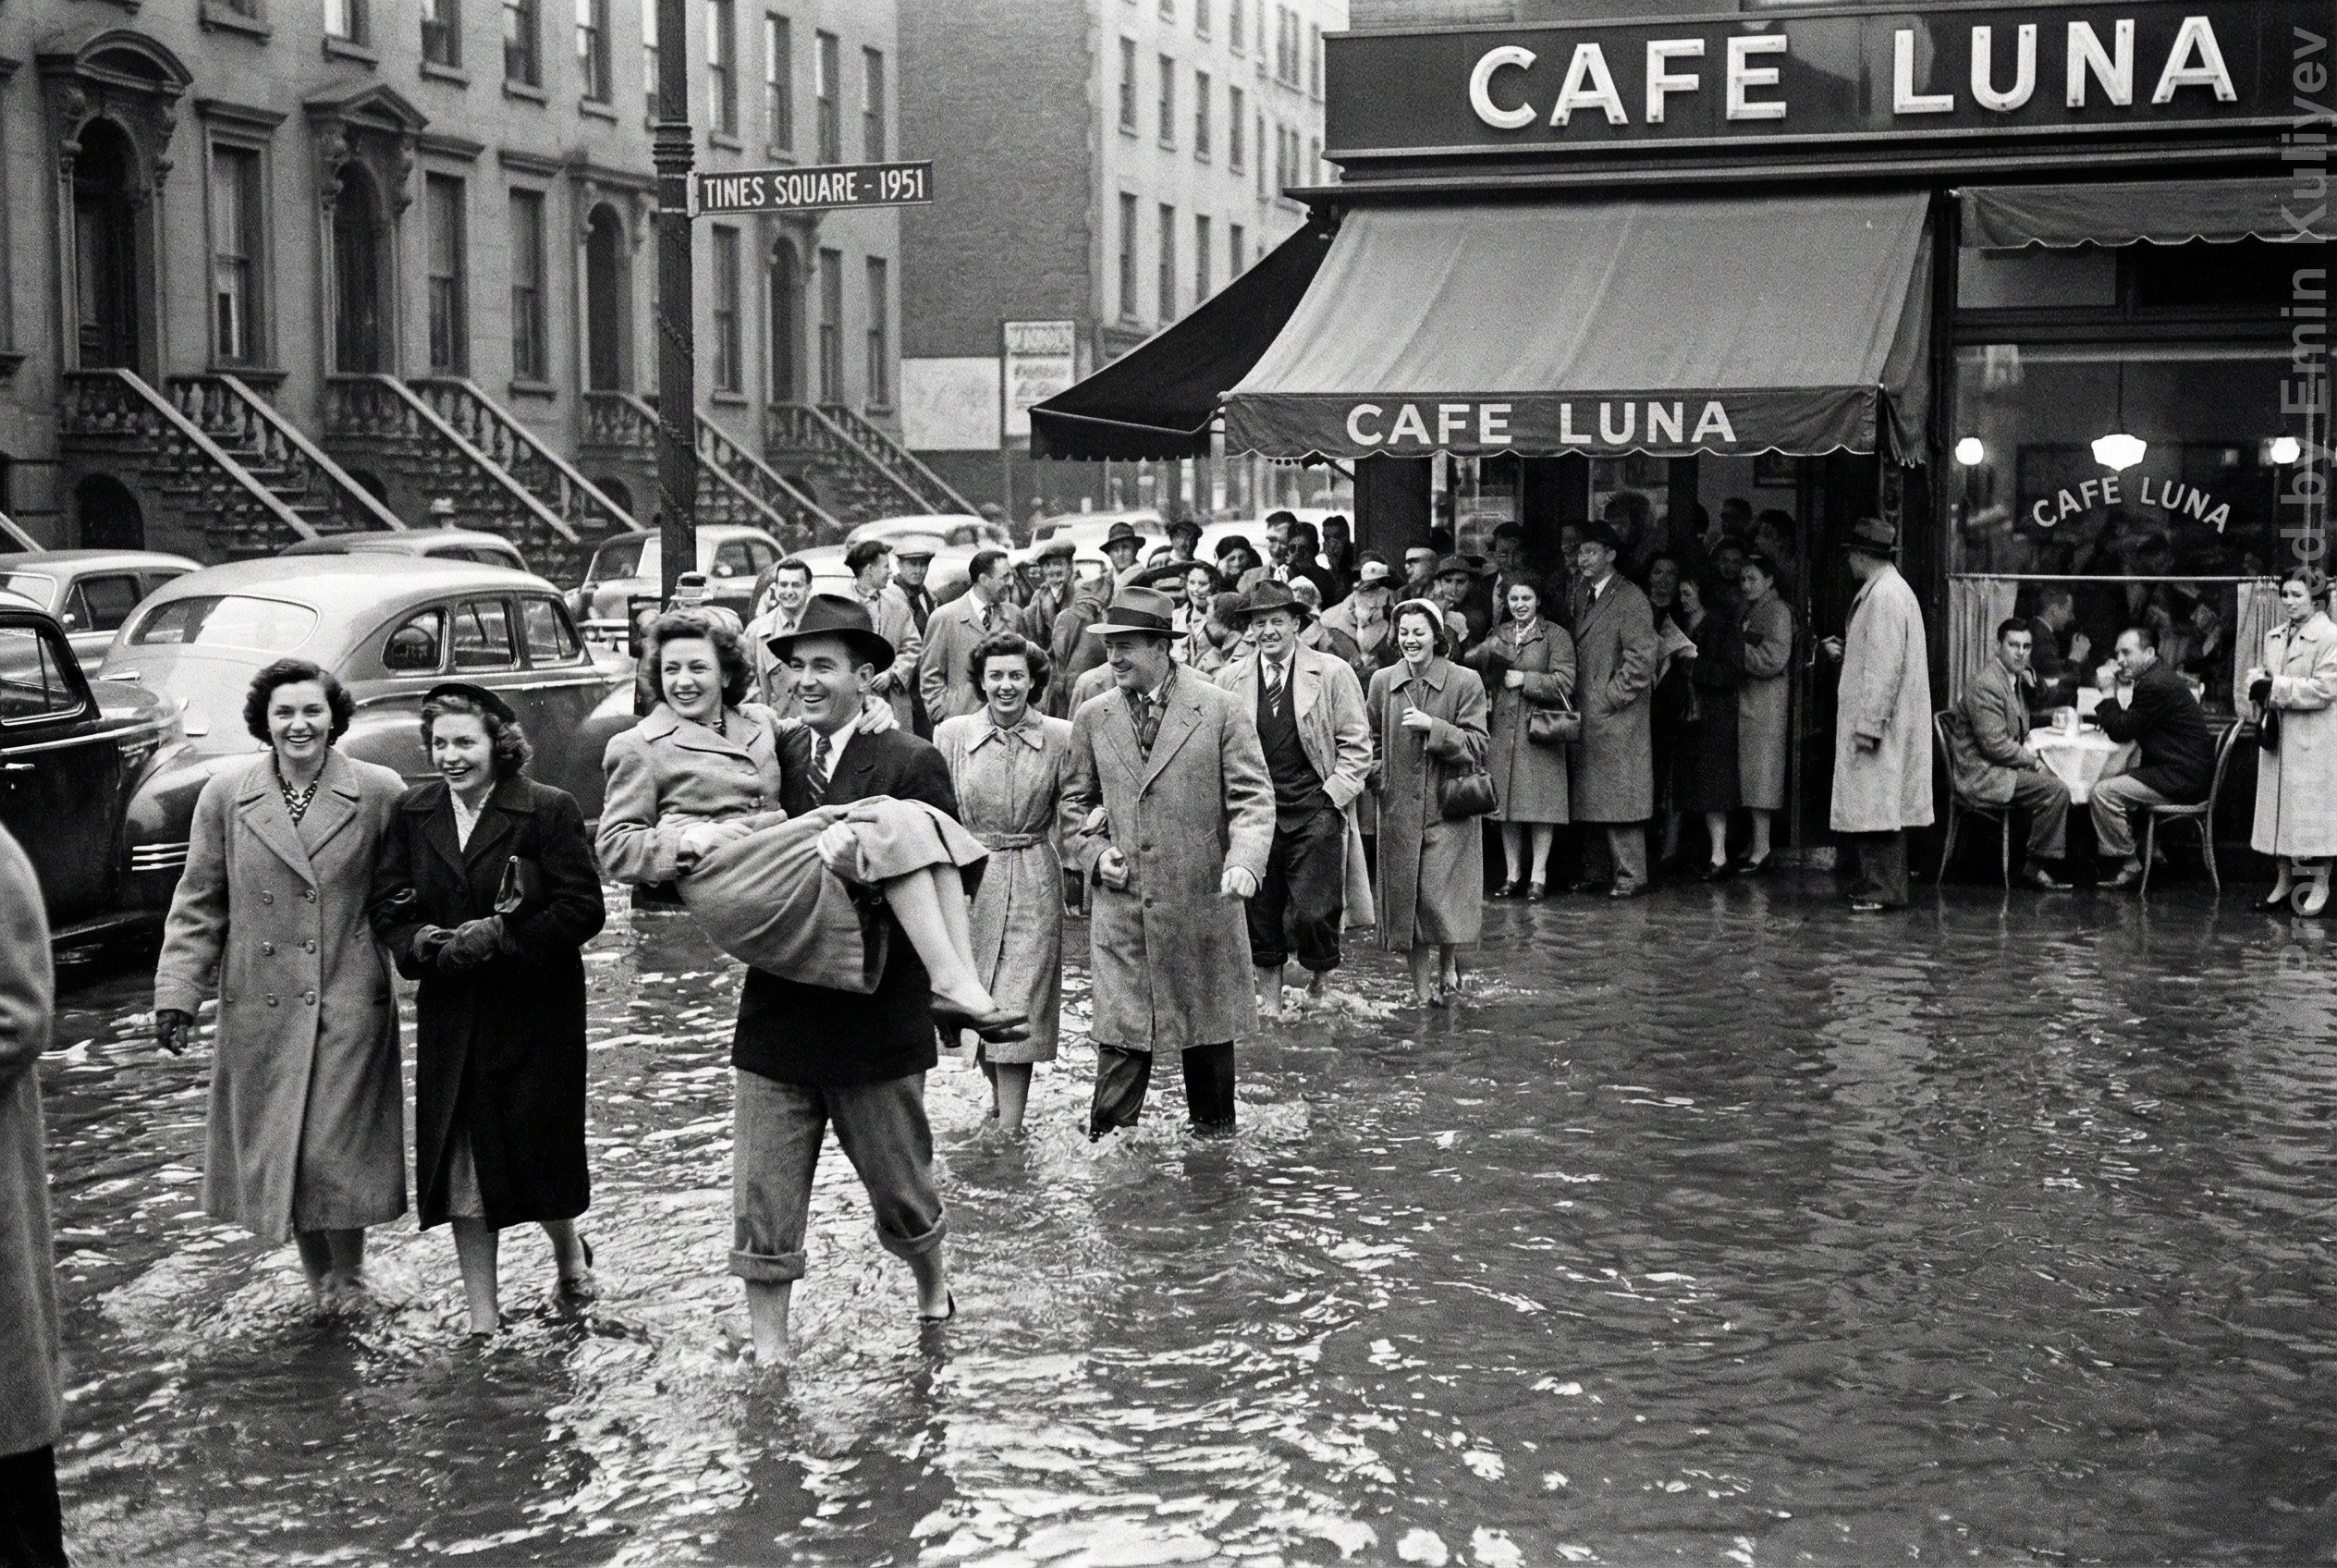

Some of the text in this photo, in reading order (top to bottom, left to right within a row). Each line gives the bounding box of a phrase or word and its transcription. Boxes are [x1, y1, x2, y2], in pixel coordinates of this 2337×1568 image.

[1469, 15, 2238, 129] CAFE LUNA
[704, 177, 765, 208] TINES
[775, 172, 858, 205] SQUARE
[880, 168, 924, 200] 1951
[1345, 401, 1737, 446] CAFE LUNA
[2032, 476, 2231, 534] CAFE LUNA
